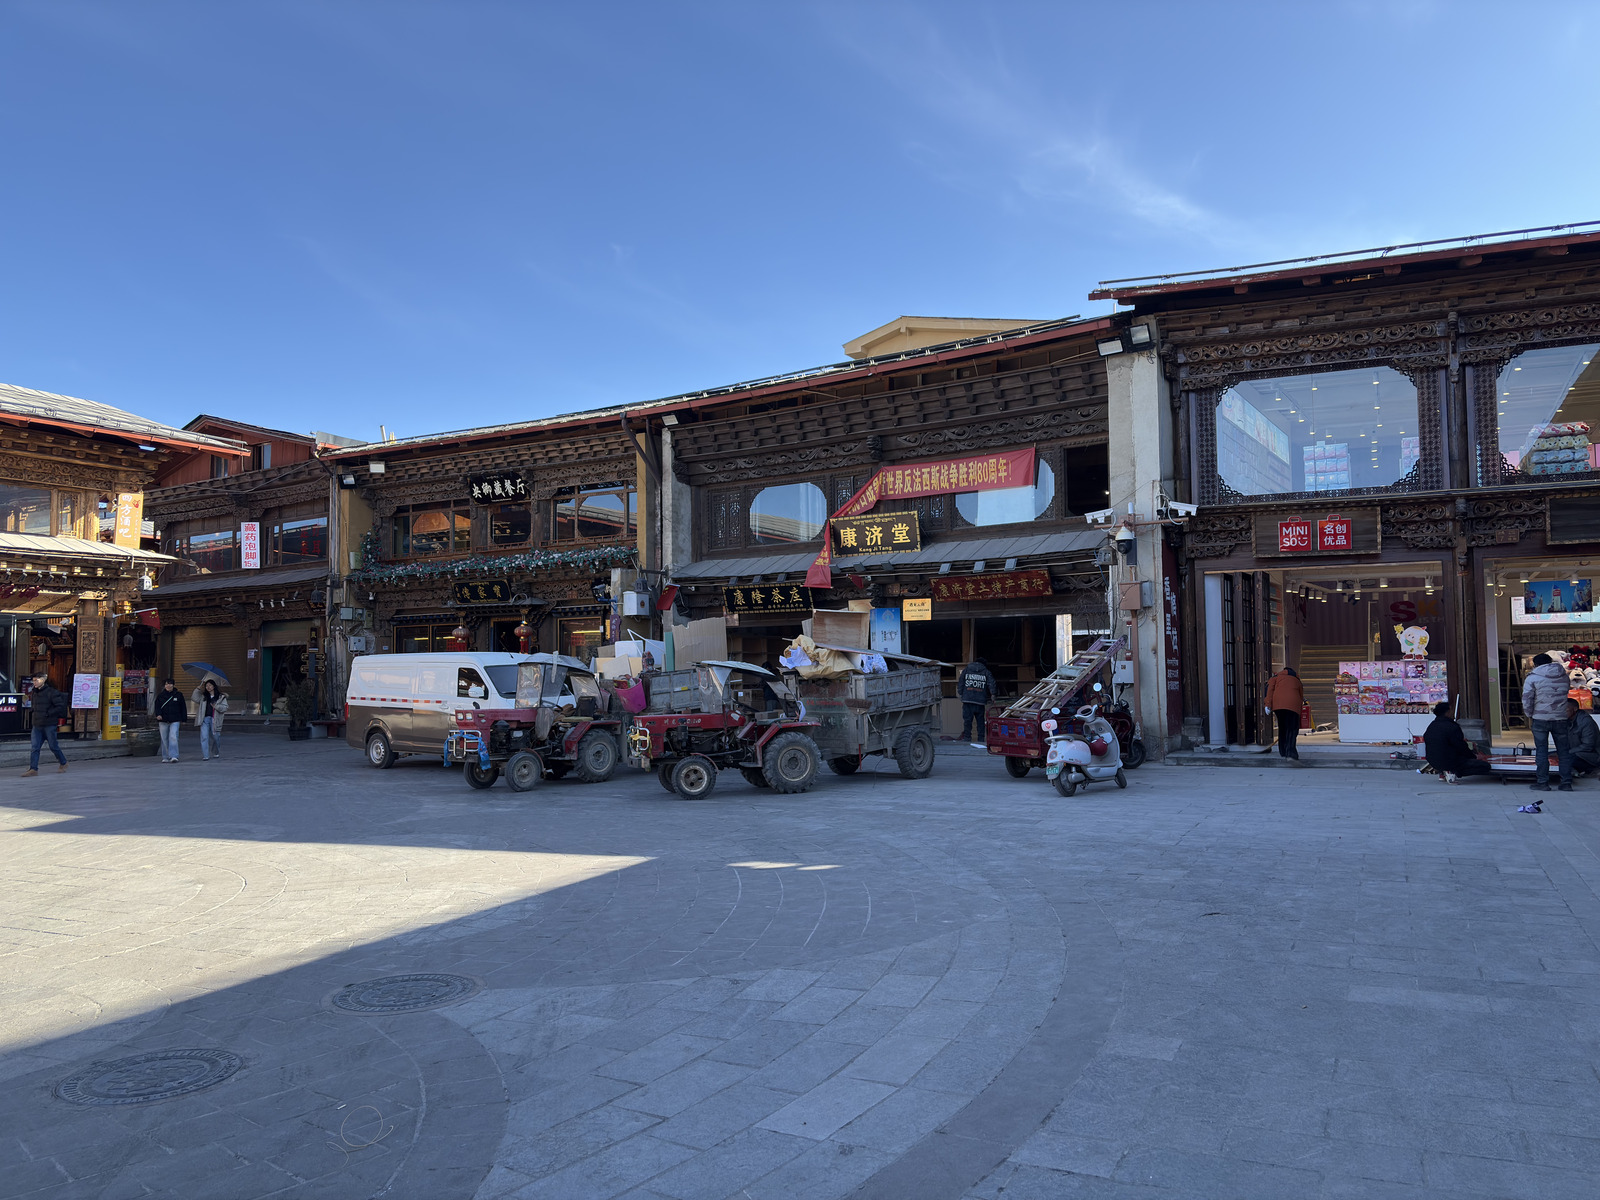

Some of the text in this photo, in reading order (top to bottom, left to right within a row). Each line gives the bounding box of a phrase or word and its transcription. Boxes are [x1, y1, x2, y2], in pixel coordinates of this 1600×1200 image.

[119, 495, 133, 538] 四方酒吧
[1282, 525, 1308, 536] MINI
[1324, 523, 1347, 534] 名创
[840, 522, 911, 548] 康济堂
[1324, 535, 1347, 546] 优品
[244, 523, 257, 560] 藏药泡脚
[965, 673, 987, 682] FASHION
[965, 680, 986, 689] SPORT
